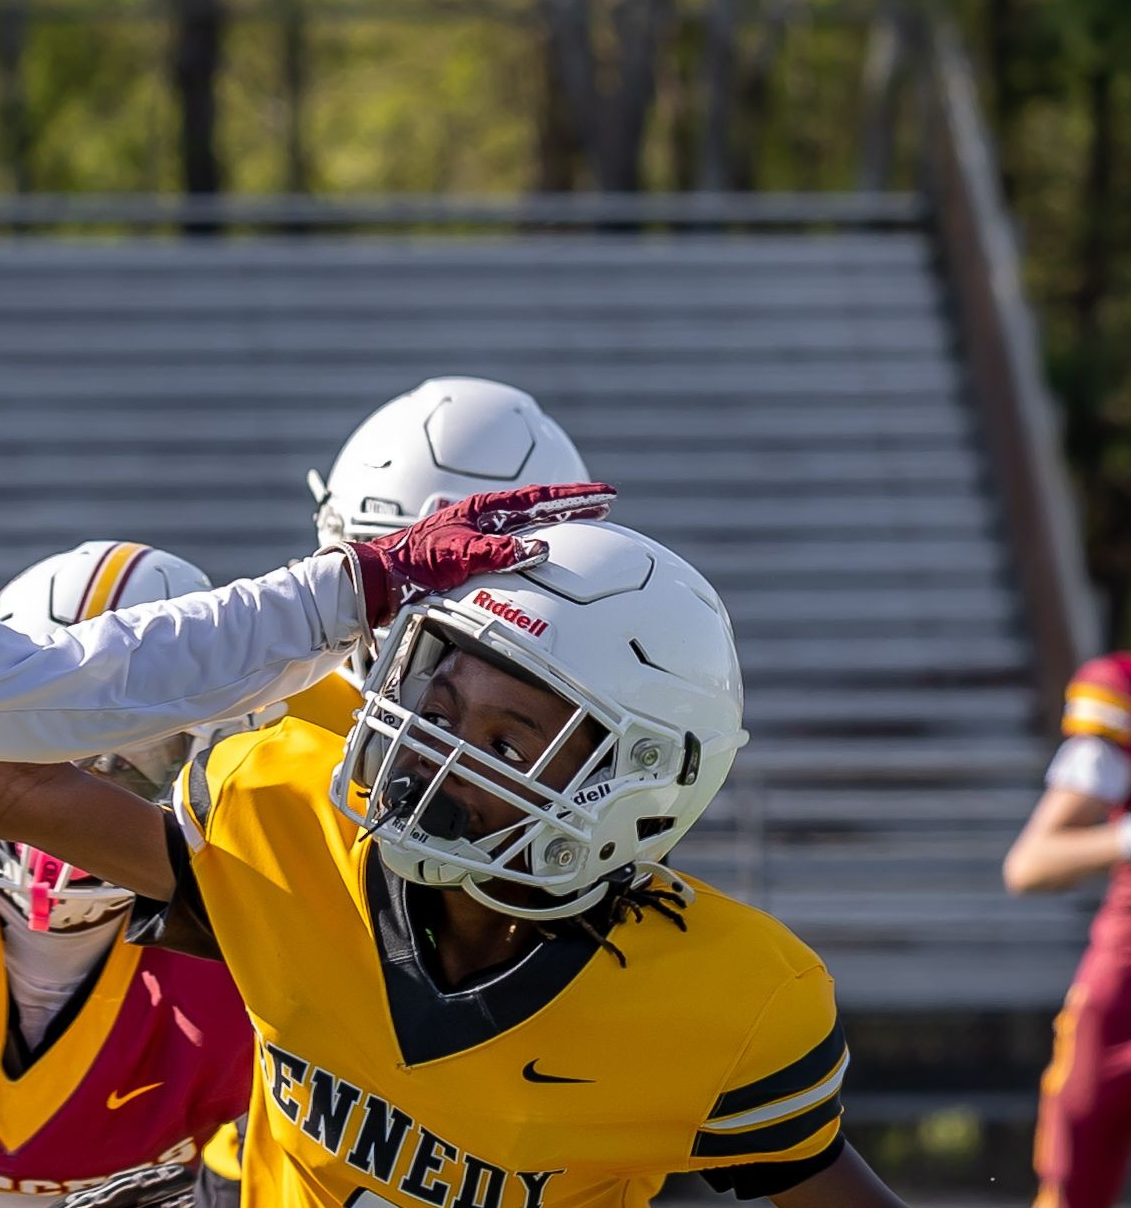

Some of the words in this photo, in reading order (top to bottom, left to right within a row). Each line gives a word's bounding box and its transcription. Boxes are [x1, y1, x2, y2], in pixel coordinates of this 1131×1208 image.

[473, 590, 549, 638] Riddell
[573, 783, 612, 806] dell
[392, 816, 429, 844] Riell
